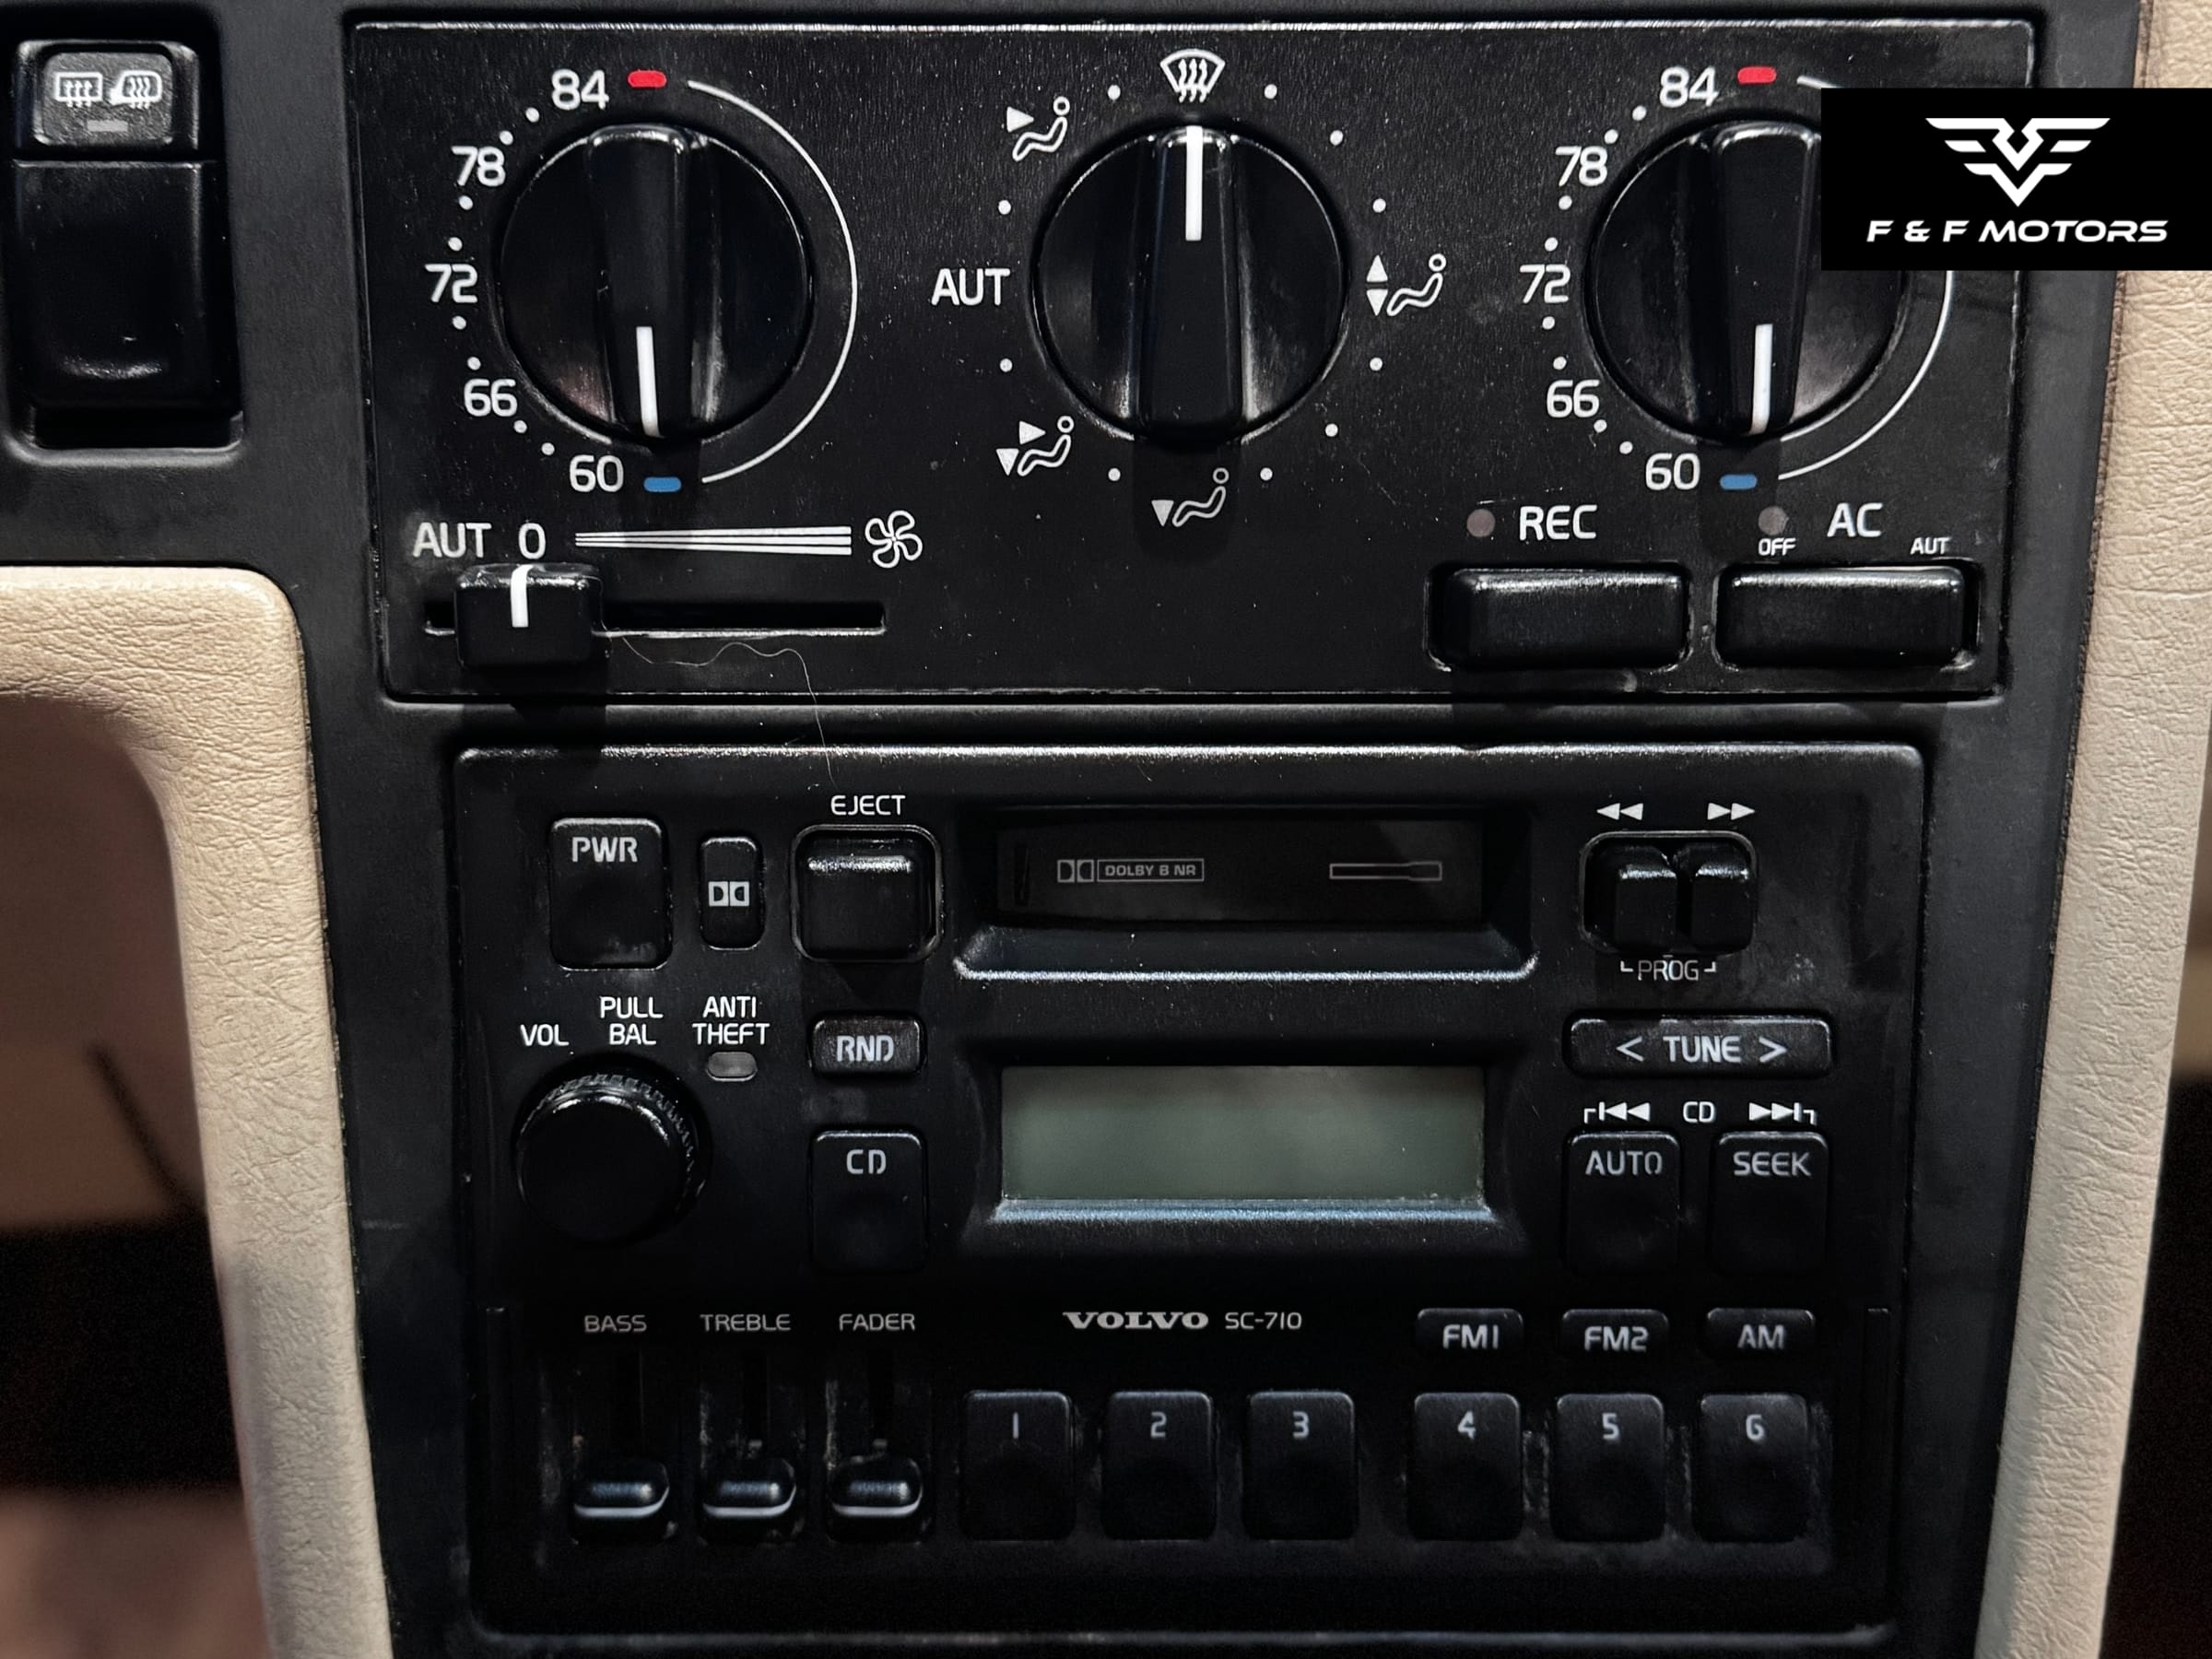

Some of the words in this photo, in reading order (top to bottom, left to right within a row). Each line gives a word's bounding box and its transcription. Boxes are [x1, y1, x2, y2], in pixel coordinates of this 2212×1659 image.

[551, 68, 610, 111] 84
[1659, 65, 1720, 108] 84
[451, 146, 506, 187] 78
[1555, 145, 1608, 187] 78
[424, 263, 478, 303] 72
[931, 267, 1011, 306] AUT
[1519, 264, 1571, 304] 72
[464, 378, 518, 418] 66
[1547, 379, 1600, 418] 66
[569, 454, 624, 493] 60
[1645, 453, 1700, 490] 60
[1519, 504, 1597, 541] REC
[1827, 502, 1883, 537] AC
[411, 522, 492, 559] AUT
[1758, 536, 1796, 556] OFF
[1910, 536, 1951, 555] AUT
[830, 794, 906, 816] EJECT
[571, 836, 638, 863] PWR
[1104, 865, 1155, 877] DOLBY
[1159, 864, 1170, 877] B
[1173, 864, 1196, 877] NR
[1637, 959, 1699, 982] PROG
[599, 996, 664, 1019] PULL
[702, 995, 757, 1018] ANTI
[520, 1023, 570, 1047] VOL
[609, 1022, 657, 1046] BAL
[691, 1022, 771, 1045] THEFT
[836, 1035, 895, 1063] RND
[1662, 1035, 1742, 1063] TUNE
[1682, 1100, 1715, 1124] CD
[846, 1148, 887, 1175] CD
[1585, 1150, 1663, 1175] AUTO
[1733, 1151, 1811, 1176] SEEK
[583, 1314, 647, 1333] BASS
[700, 1313, 791, 1332] TREBLE
[839, 1312, 915, 1331] FADER
[1062, 1312, 1209, 1330] VOLVO
[1224, 1312, 1302, 1330] SC-710
[1442, 1324, 1499, 1348] FM1
[1584, 1325, 1649, 1350] FM2
[1738, 1324, 1785, 1348] AM
[1012, 1412, 1019, 1439] 1
[1150, 1411, 1168, 1439] 2
[1292, 1410, 1310, 1439] 3
[1457, 1410, 1477, 1439] 4
[1602, 1412, 1620, 1441] 5
[1746, 1414, 1765, 1441] 6
